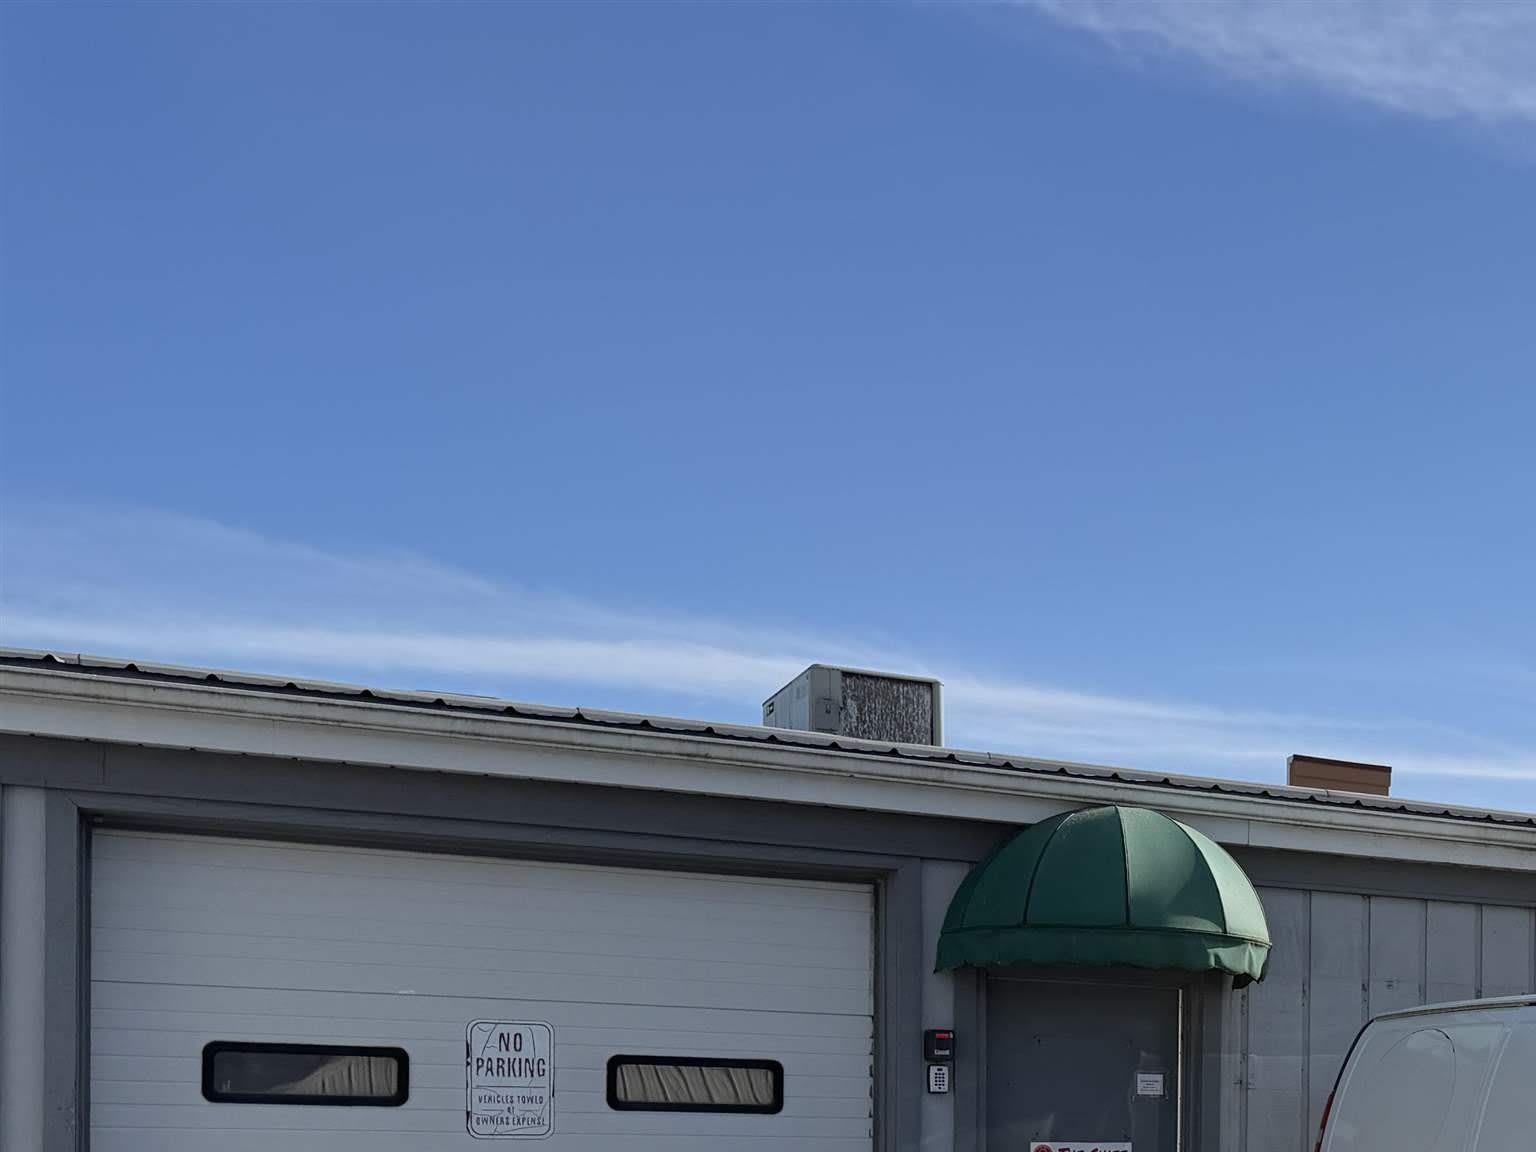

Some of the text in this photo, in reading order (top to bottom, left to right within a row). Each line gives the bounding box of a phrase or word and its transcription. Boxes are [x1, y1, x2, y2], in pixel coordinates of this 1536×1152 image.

[498, 1032, 523, 1052] NO
[476, 1057, 546, 1078] PARKING
[478, 1095, 544, 1104] VEHICLES TOWED
[476, 1116, 545, 1126] OWNERS EXPENSE
